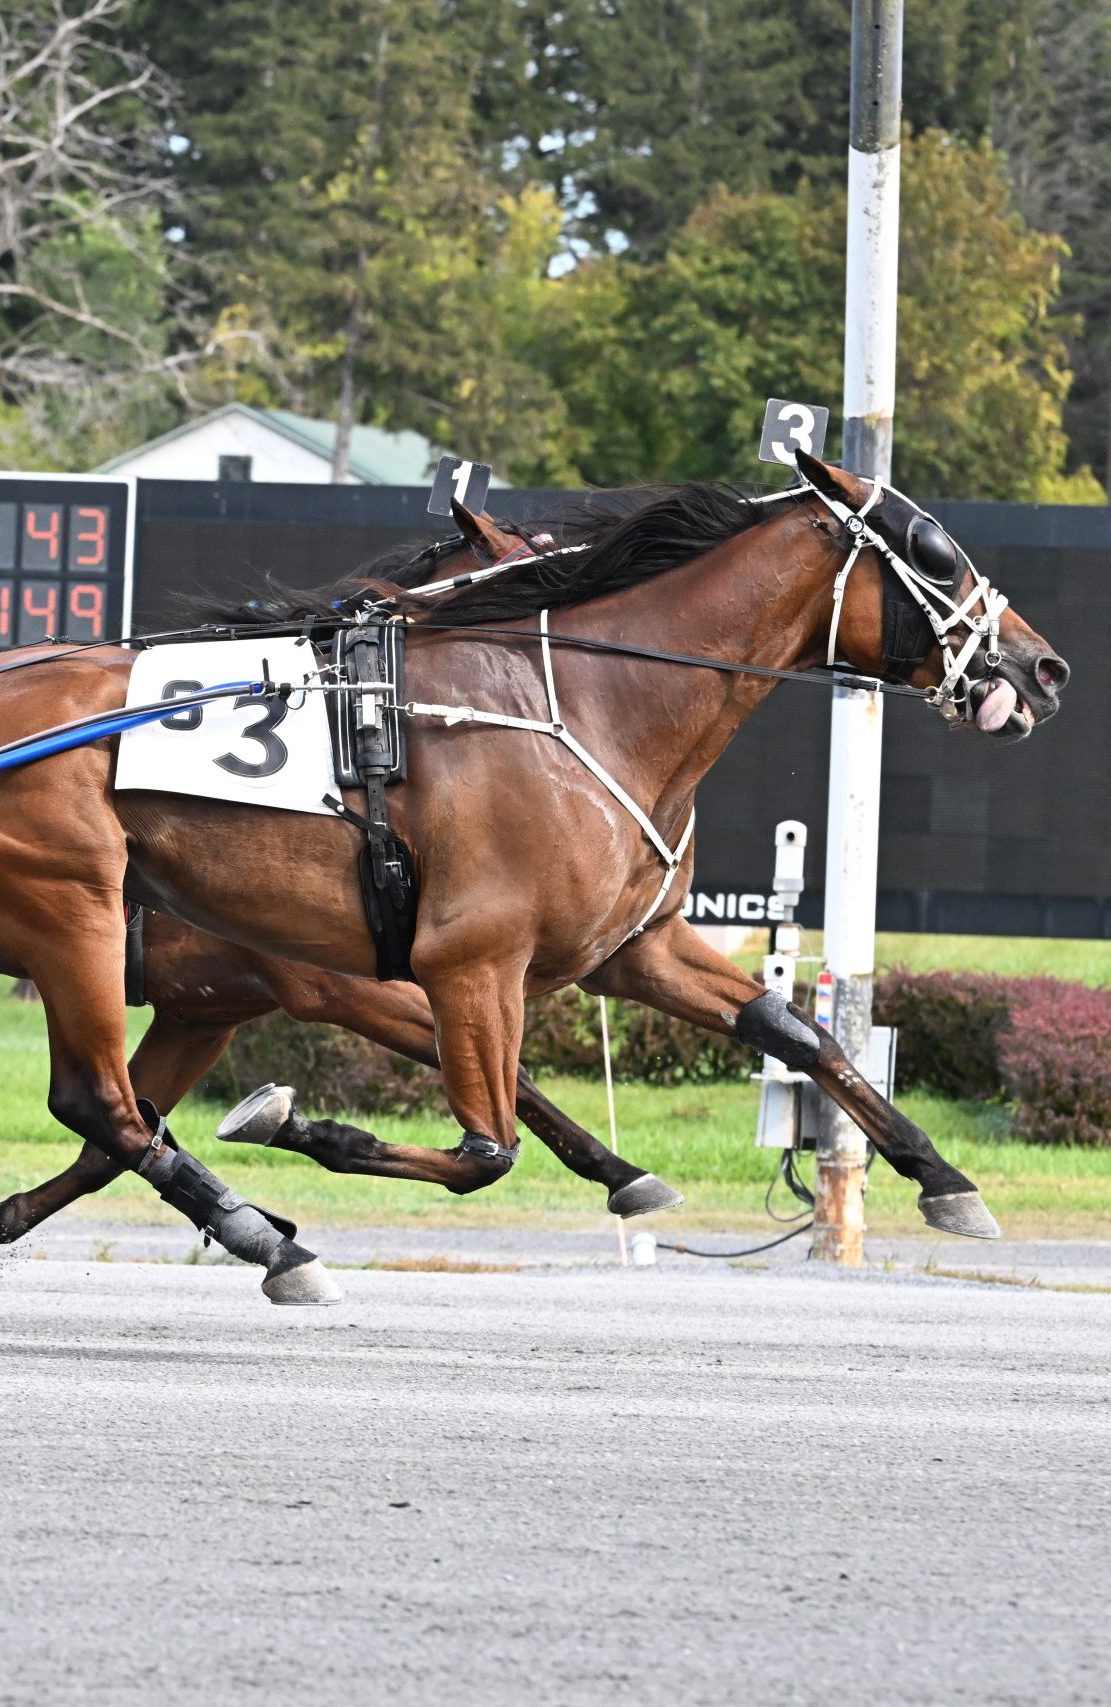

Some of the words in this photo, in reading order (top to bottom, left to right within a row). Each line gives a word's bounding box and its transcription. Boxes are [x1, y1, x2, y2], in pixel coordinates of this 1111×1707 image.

[772, 404, 815, 466] 3
[449, 460, 473, 516] 1
[26, 508, 106, 565] 43
[0, 585, 104, 636] 149
[212, 694, 288, 778] 3
